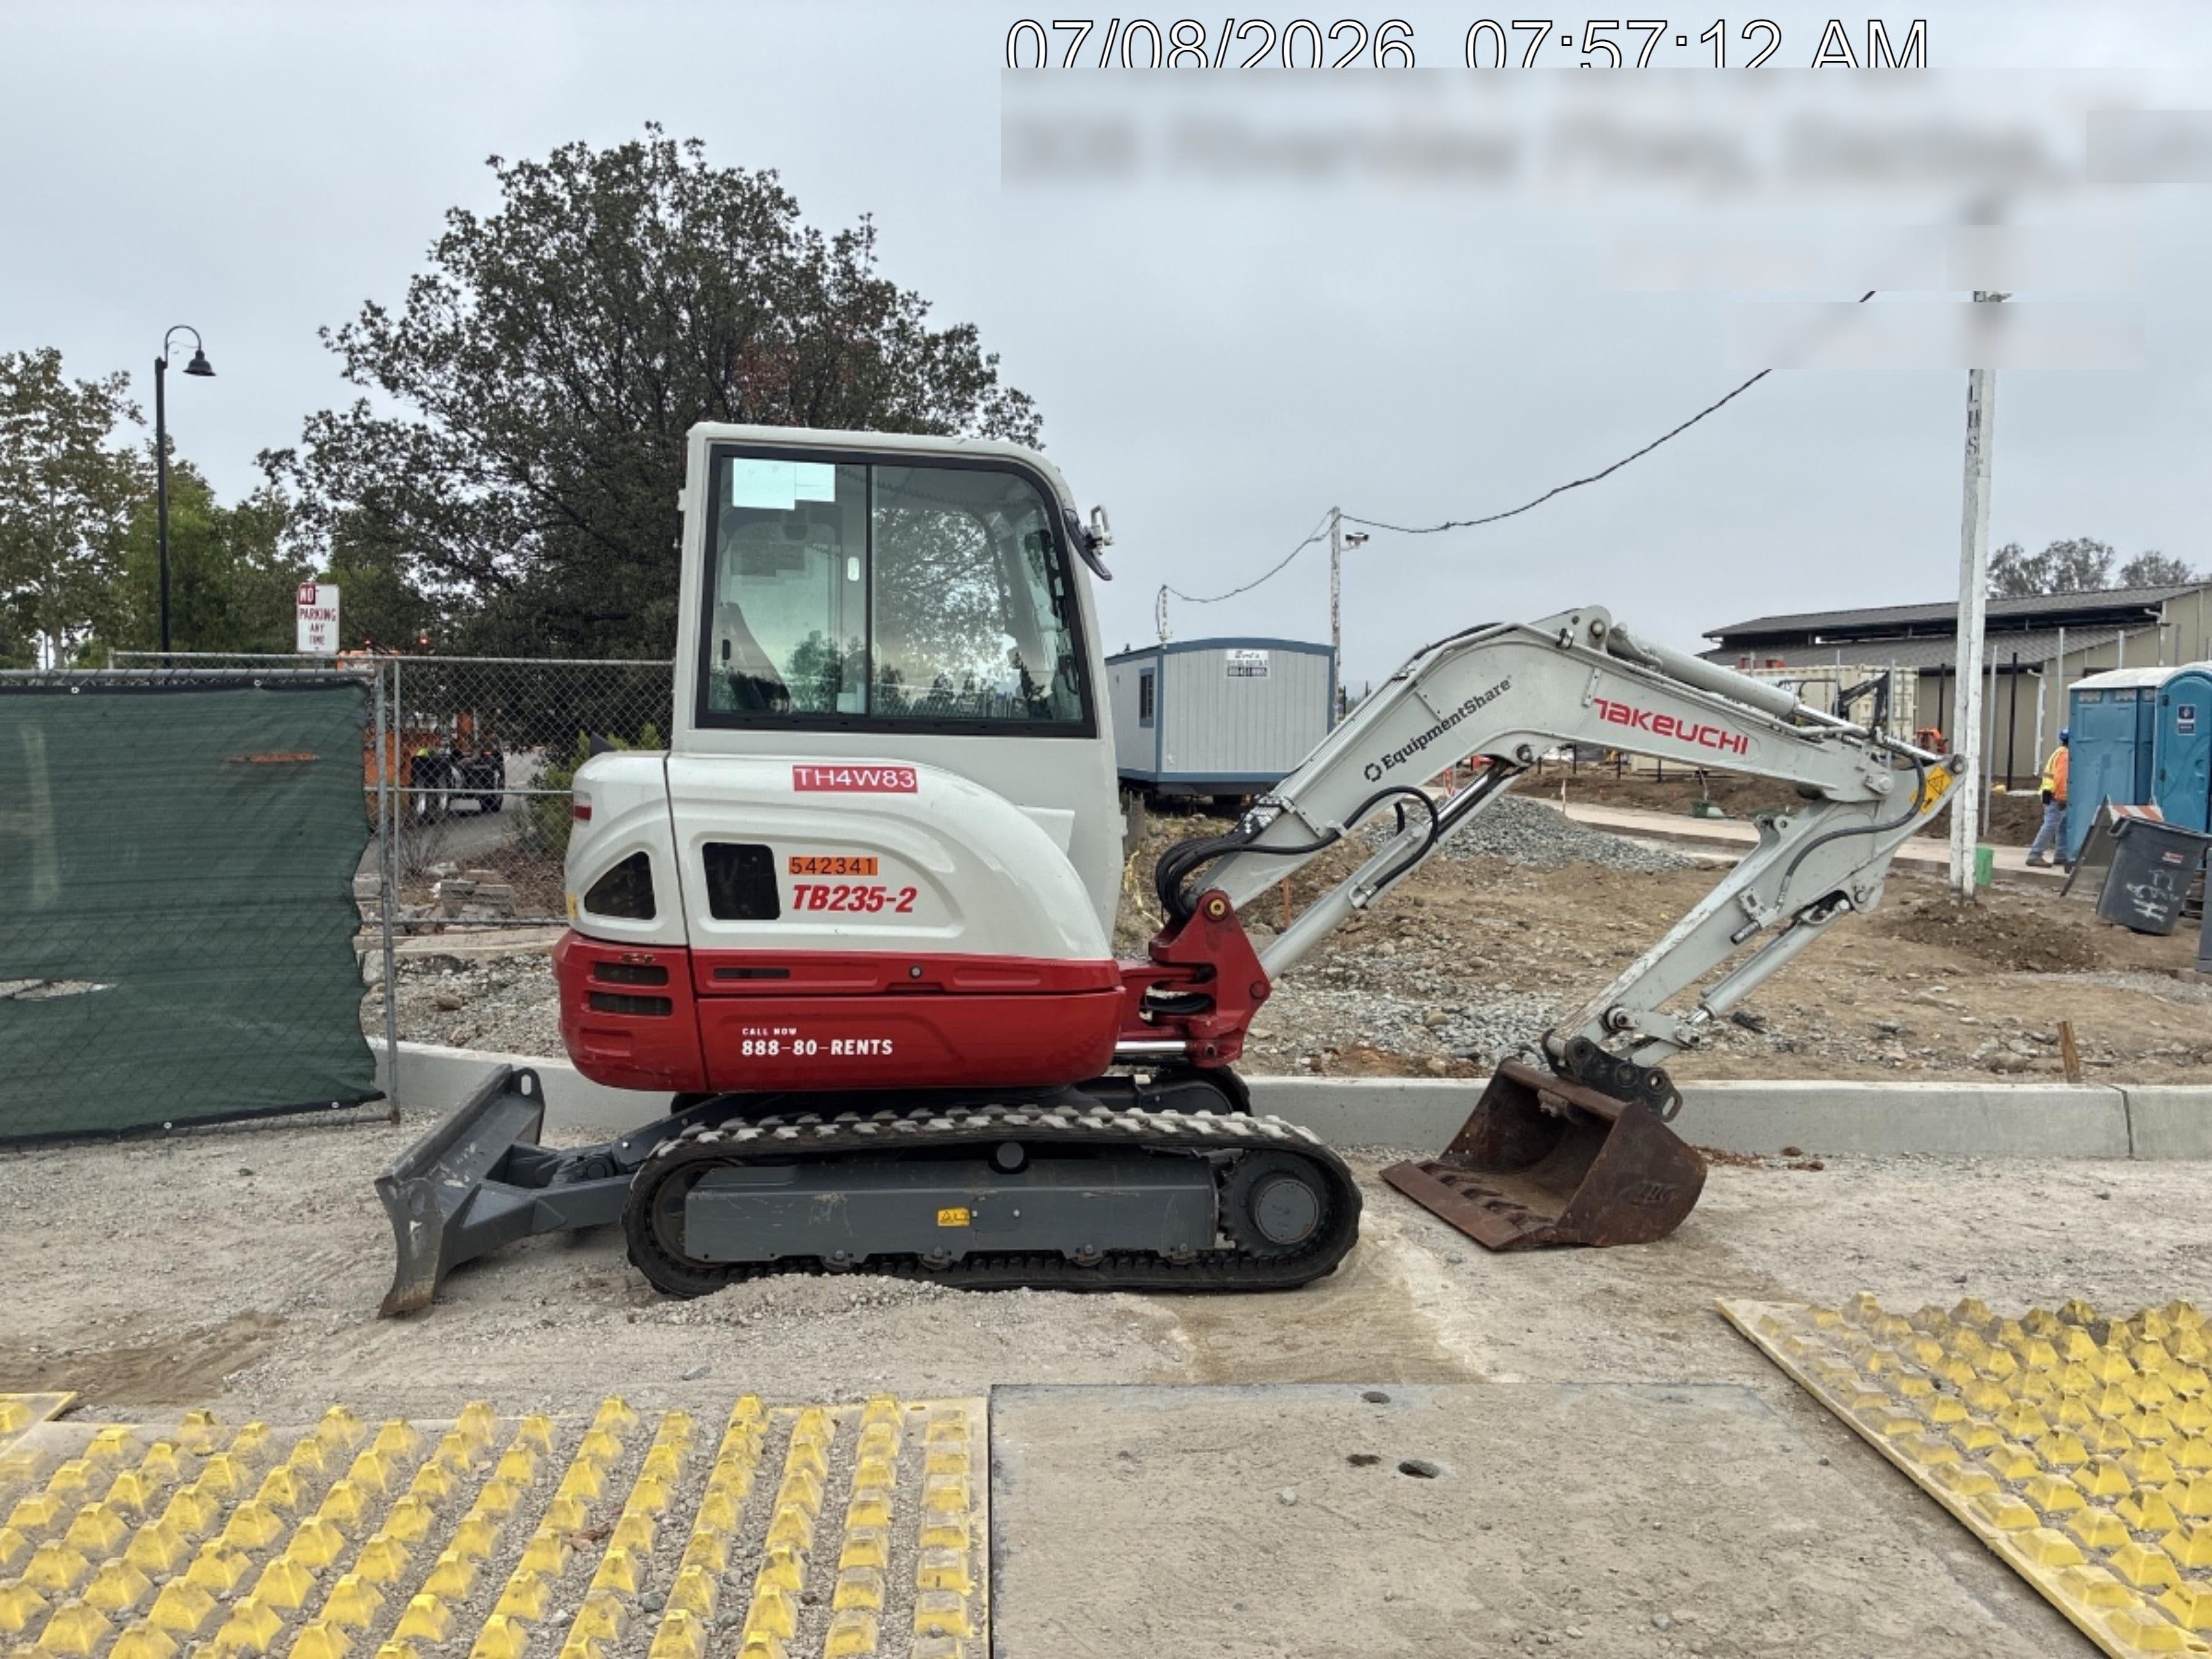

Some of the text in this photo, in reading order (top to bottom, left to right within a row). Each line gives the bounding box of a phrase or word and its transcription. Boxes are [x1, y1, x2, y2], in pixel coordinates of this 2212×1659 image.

[299, 587, 315, 602] NO
[298, 608, 336, 622] PARKING
[310, 623, 324, 633] ANY
[1381, 678, 1512, 771] EquipmentShare
[794, 768, 915, 788] TH4W83
[790, 857, 874, 875] 542341
[792, 885, 917, 913] TB235-2
[742, 1027, 798, 1036] CALL NOW
[742, 1039, 893, 1056] 888-80-RENTS
